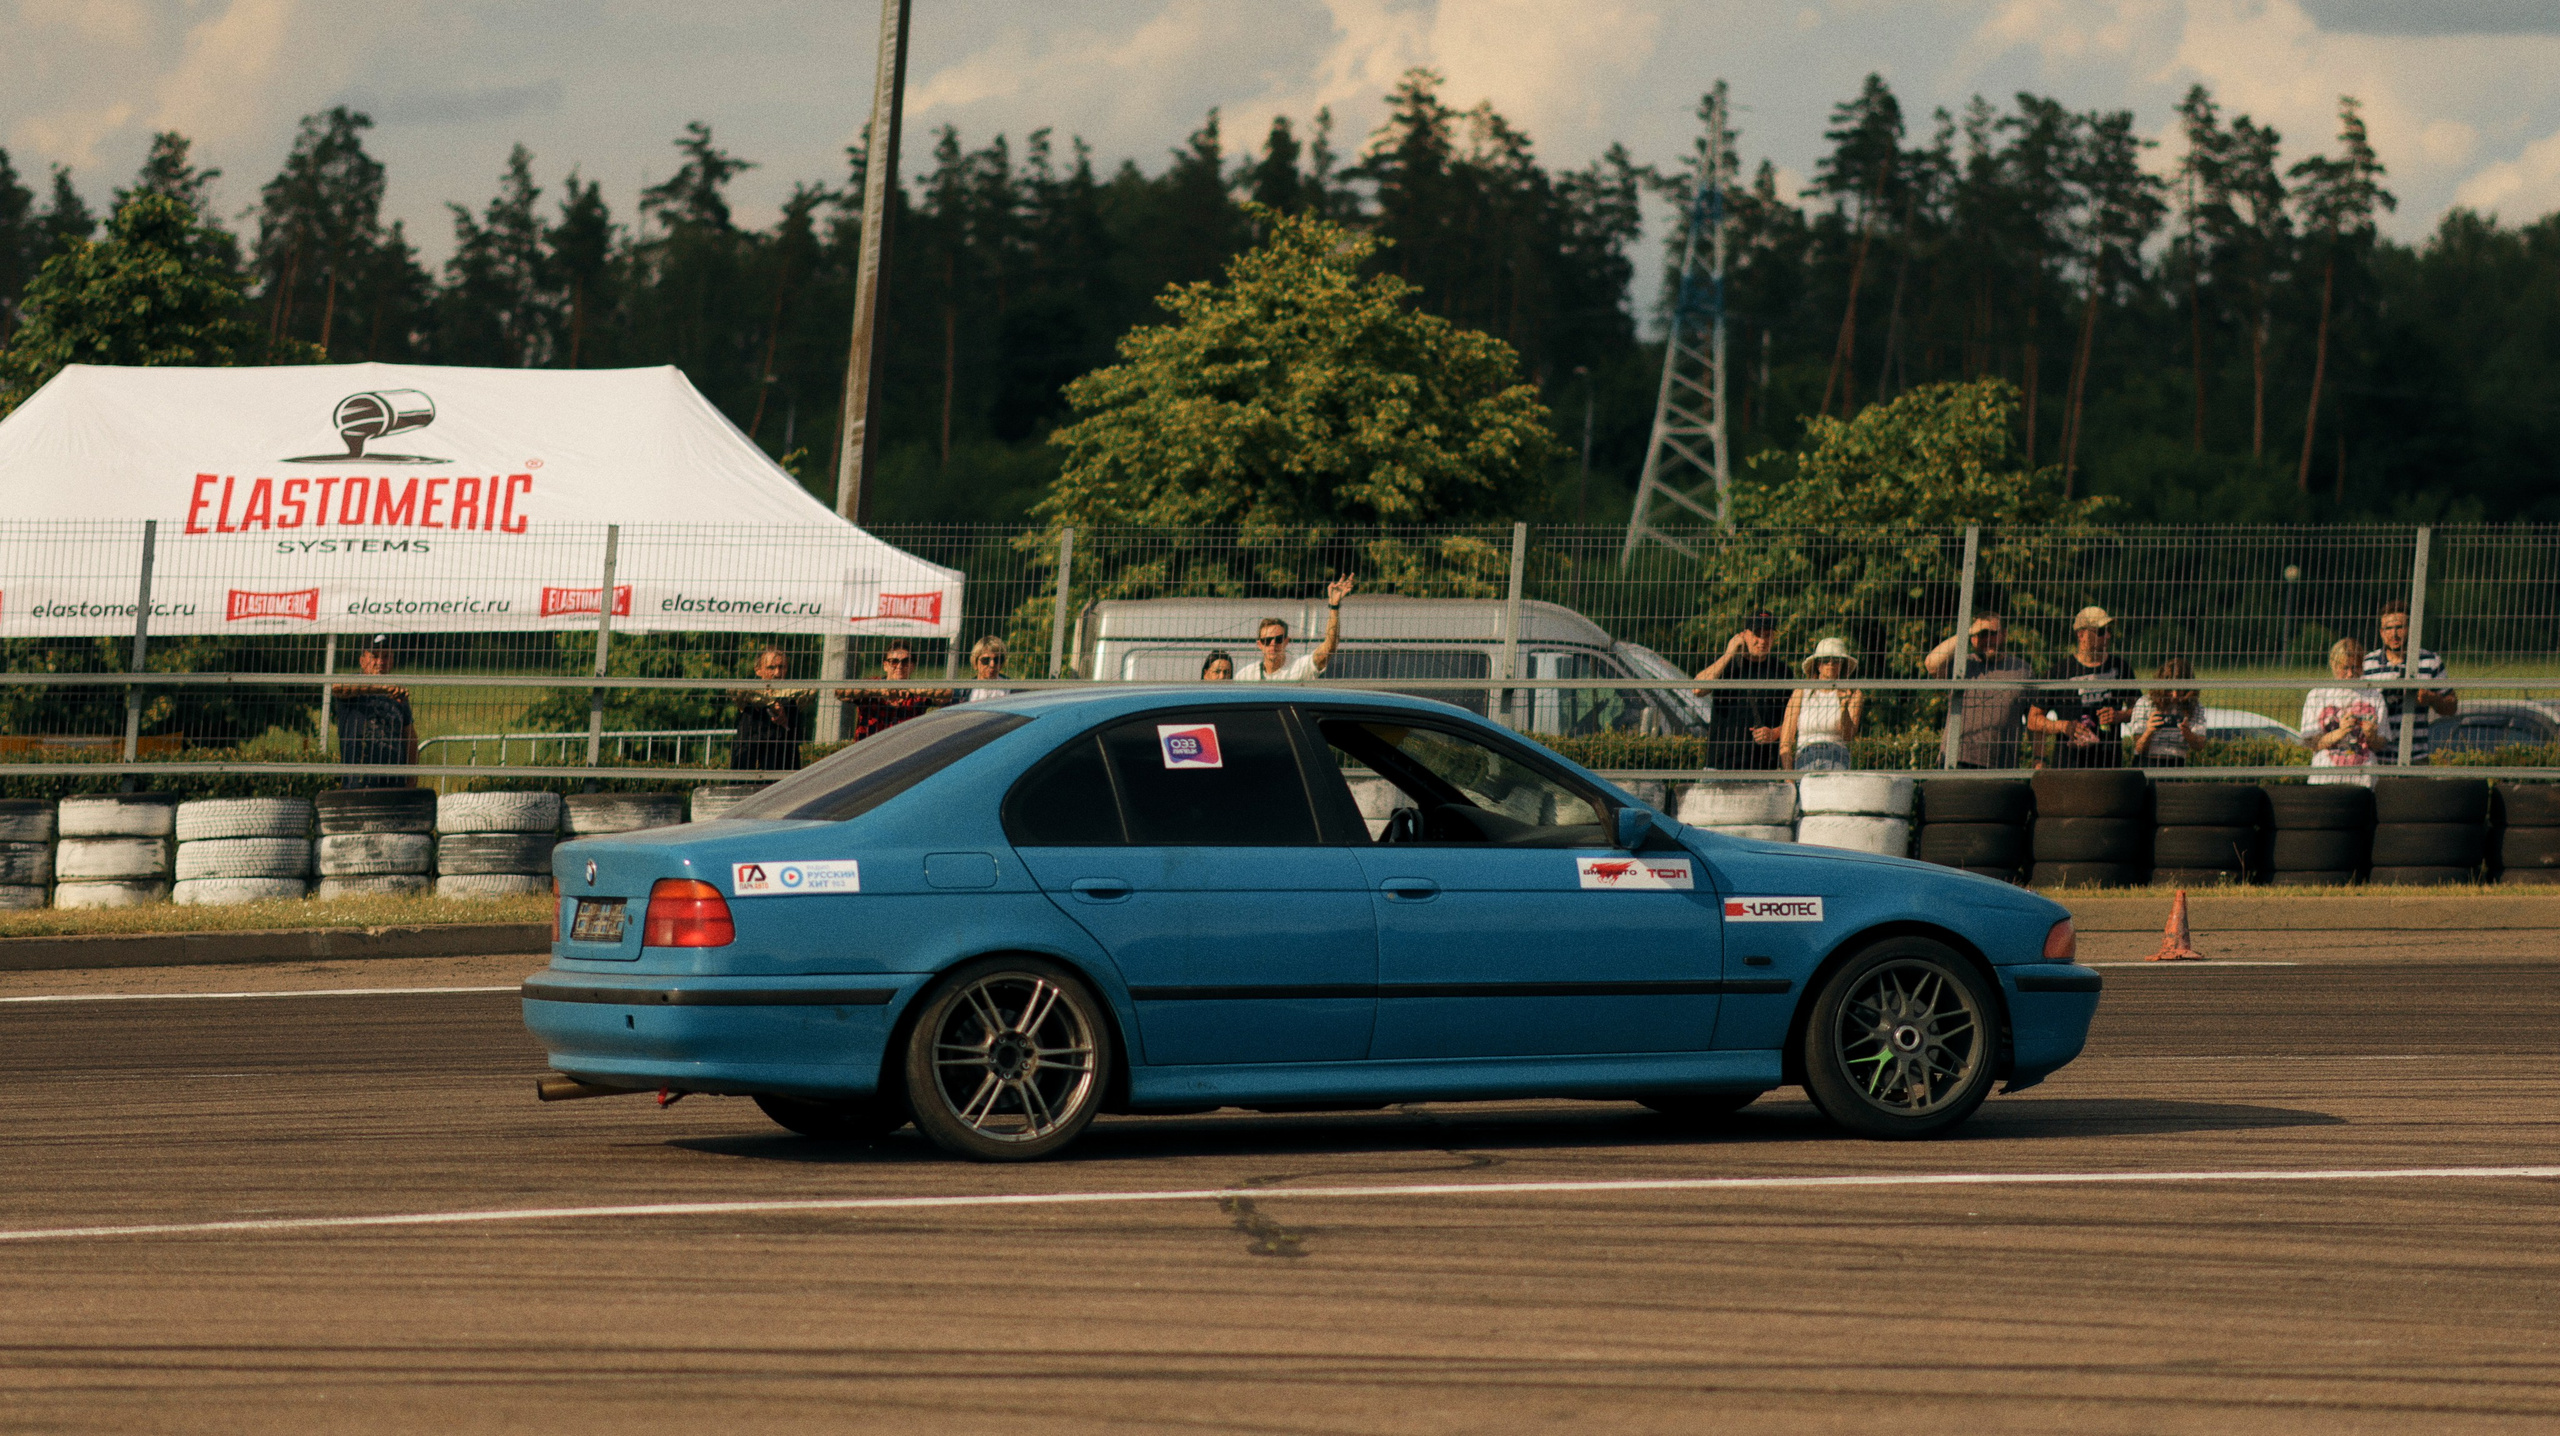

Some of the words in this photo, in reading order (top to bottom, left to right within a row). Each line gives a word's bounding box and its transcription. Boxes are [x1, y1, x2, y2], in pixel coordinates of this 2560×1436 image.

[185, 473, 533, 535] ELASTOMERIC
[277, 539, 431, 554] SYSTEMS
[32, 600, 197, 618] elastomeic.ru
[233, 592, 312, 617] ELASTOMERIC
[347, 596, 511, 615] elastomeric.ru
[547, 588, 625, 613] ELASTOMIC
[660, 593, 822, 615] elastomeric.ru
[878, 596, 936, 617] STOMERIC
[1742, 902, 1816, 916] SUPROTEC
